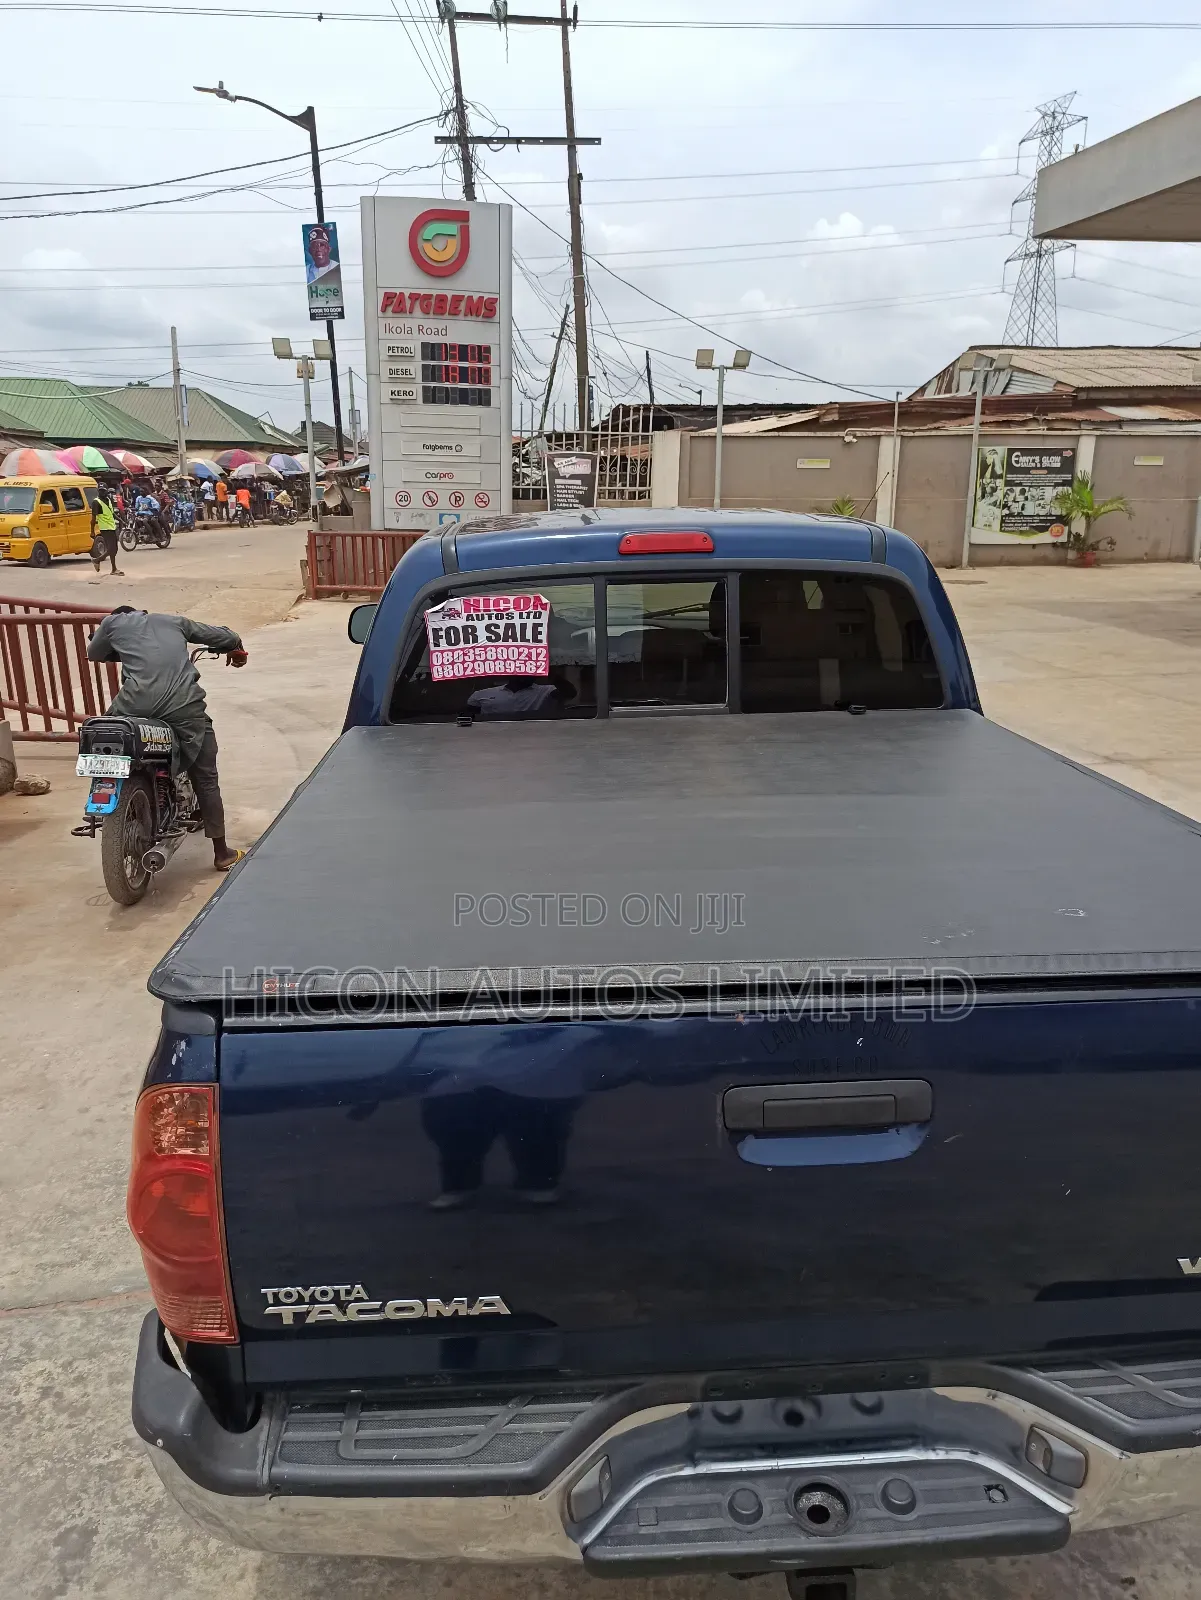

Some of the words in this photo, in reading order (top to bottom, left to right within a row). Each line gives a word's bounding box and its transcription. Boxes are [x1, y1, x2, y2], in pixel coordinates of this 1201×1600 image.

[310, 286, 339, 300] Hope
[380, 292, 499, 319] FATGBEMS
[384, 323, 413, 335] Ikola
[417, 324, 448, 337] Road
[387, 345, 413, 355] PETROL
[388, 367, 413, 377] DIESEL
[390, 389, 414, 398] KERO
[422, 443, 453, 452] Fatgbems
[398, 494, 409, 503] 20
[462, 595, 548, 614] HICON
[465, 612, 515, 622] AUTOS
[518, 611, 543, 620] LTD
[432, 625, 479, 647] FOR
[484, 622, 544, 644] SALE
[260, 1284, 369, 1304] TOYOTA
[264, 1295, 511, 1325] TACOMA
